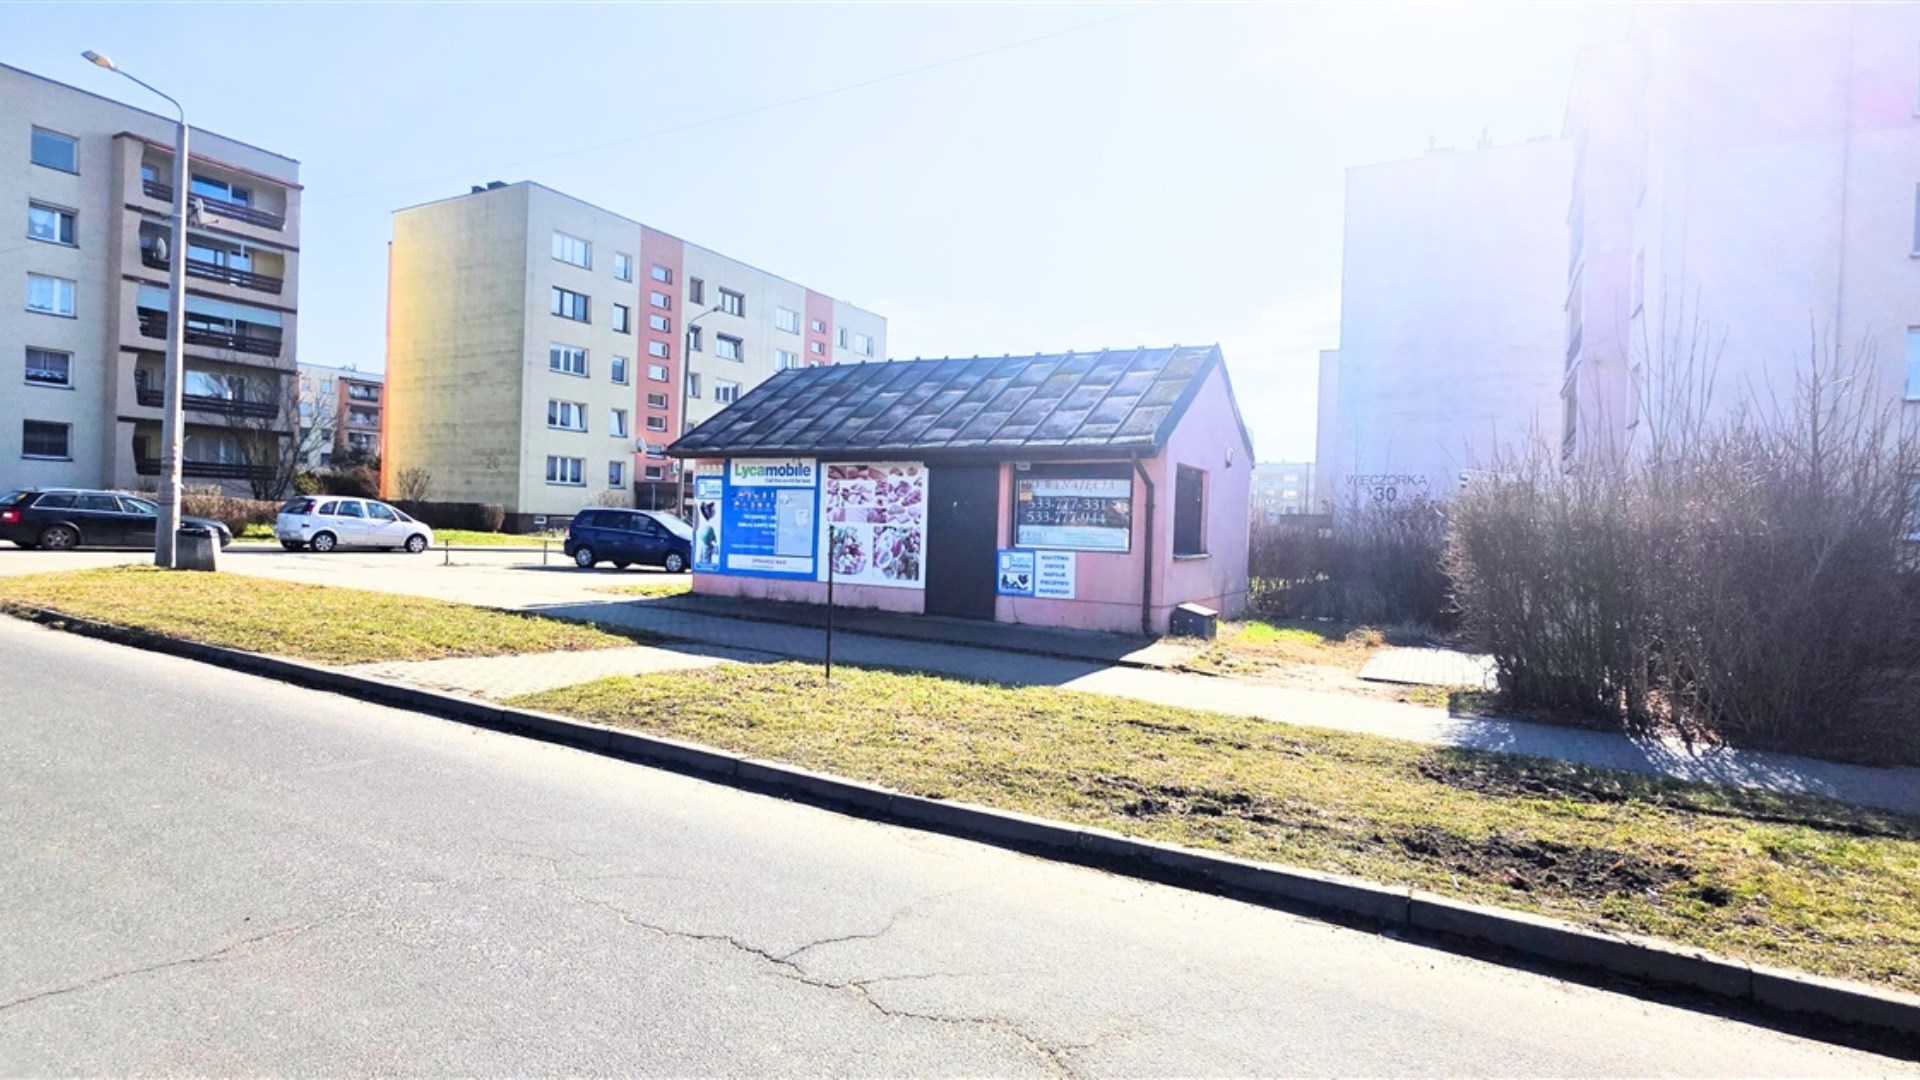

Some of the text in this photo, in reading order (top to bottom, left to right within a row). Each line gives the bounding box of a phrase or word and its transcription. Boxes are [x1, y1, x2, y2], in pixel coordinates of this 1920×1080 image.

[734, 463, 811, 479] Lycamobile
[1346, 474, 1428, 486] WIECZORKA
[1373, 487, 1397, 502] 30
